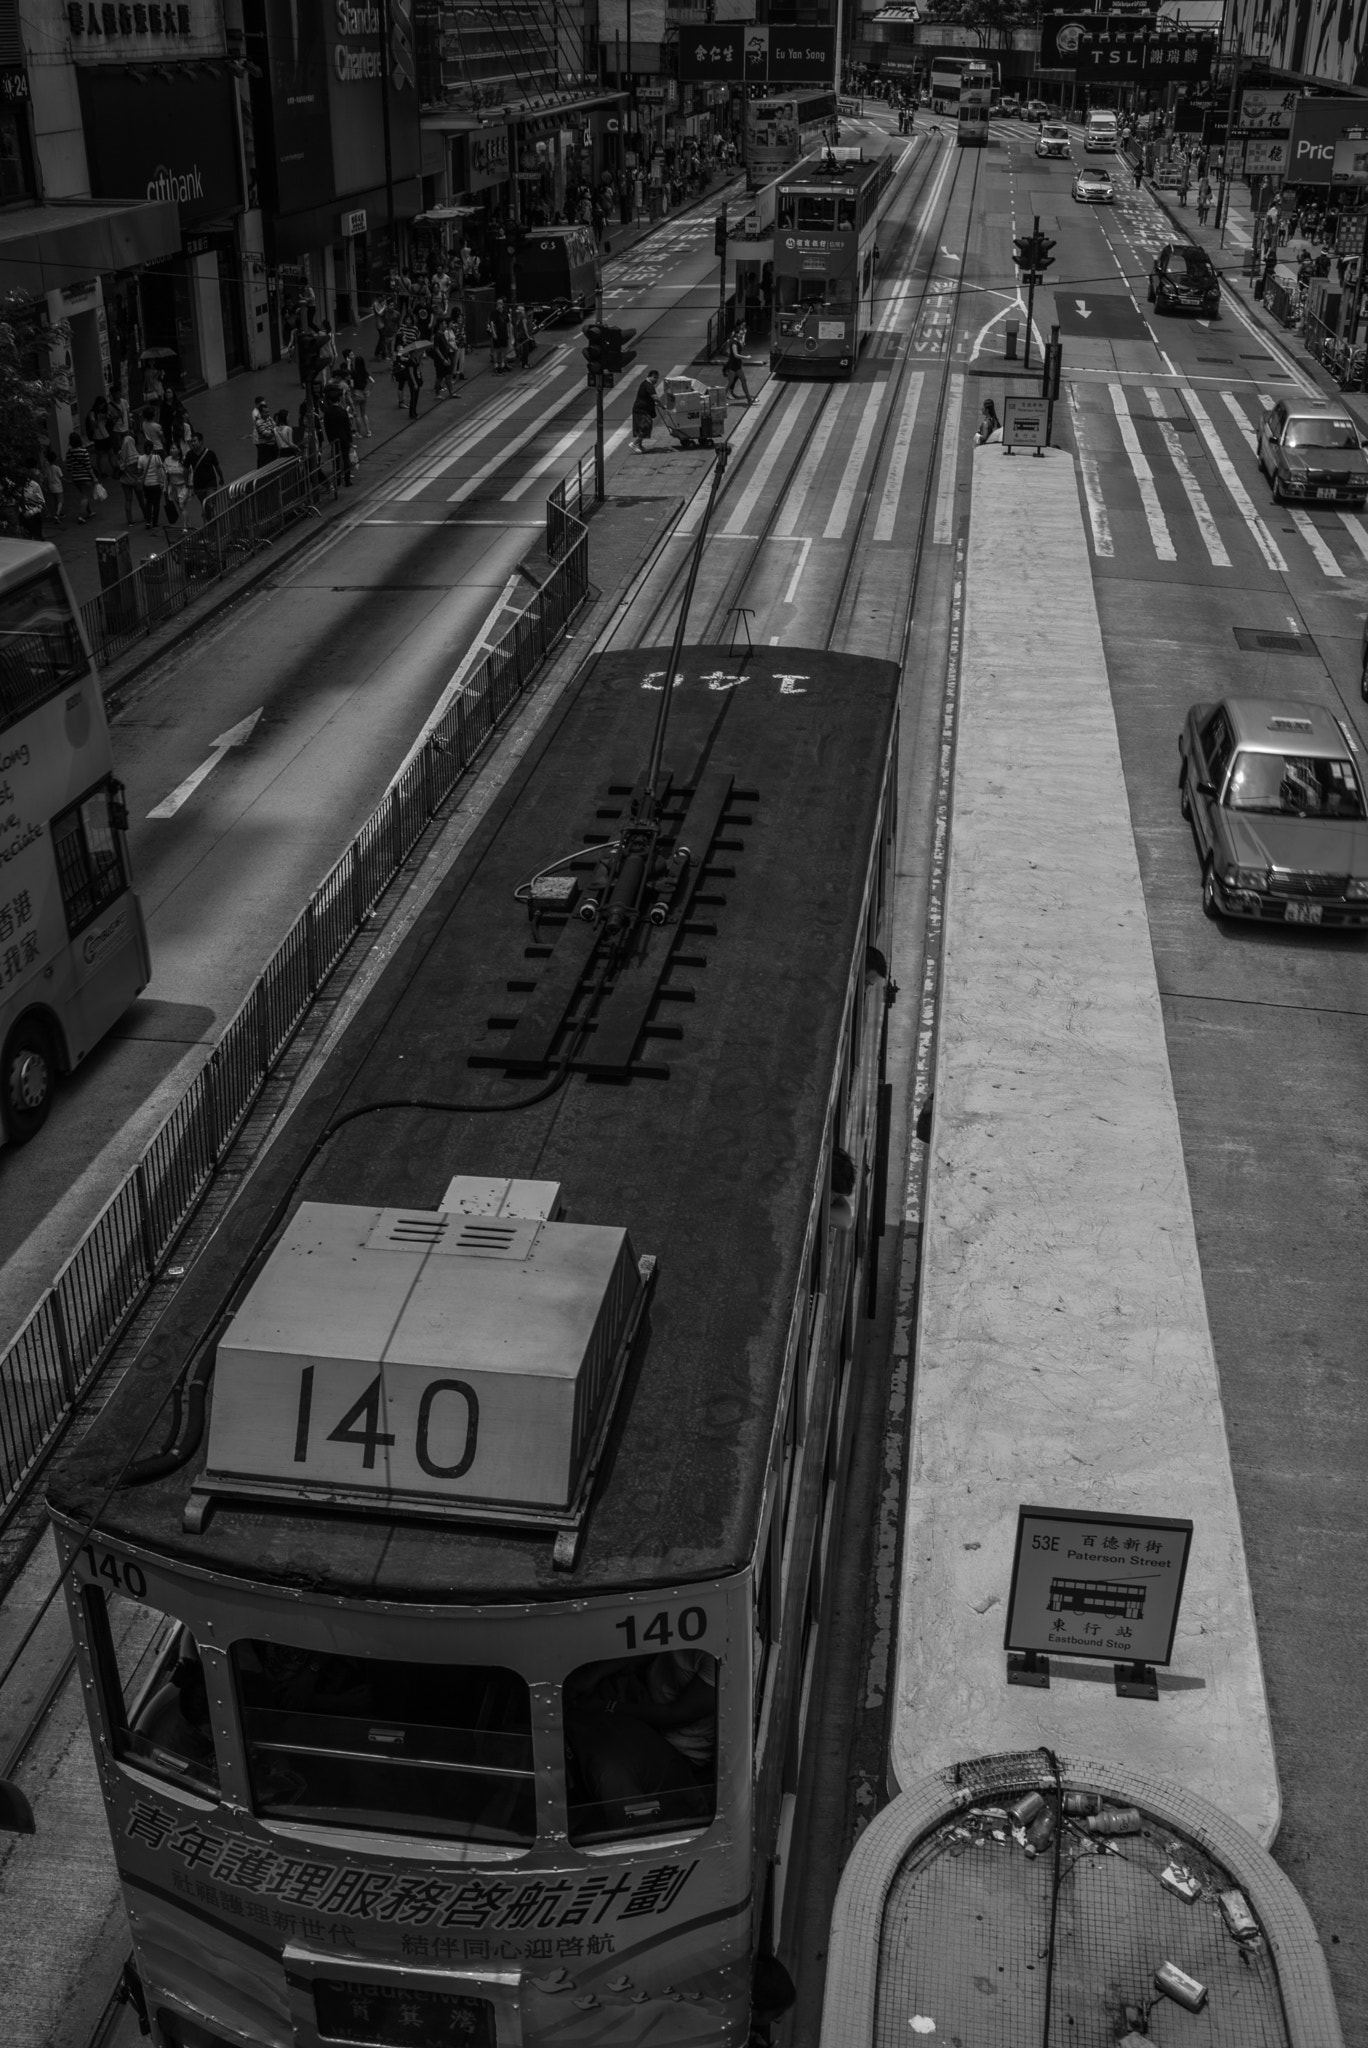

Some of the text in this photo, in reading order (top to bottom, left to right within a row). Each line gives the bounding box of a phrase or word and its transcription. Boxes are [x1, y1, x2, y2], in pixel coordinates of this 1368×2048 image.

[694, 43, 734, 62] 余仁生
[775, 48, 826, 62] Eu Yan Sang
[1091, 50, 1138, 64] TSL
[1149, 48, 1199, 65] 謝瑞麟
[146, 163, 204, 203] citibank
[293, 1364, 480, 1480] 140
[1032, 1534, 1061, 1552] 53E
[1081, 1534, 1164, 1554] 百德新街
[1066, 1549, 1172, 1569] Paterson Street
[81, 1543, 147, 1598] 140
[615, 1605, 708, 1650] 140
[1051, 1617, 1134, 1639] 東行站
[1048, 1633, 1132, 1652] Eastbound Stop
[171, 1868, 356, 1948] 社福護理新世代
[349, 1995, 476, 2034] 筲箕灣
